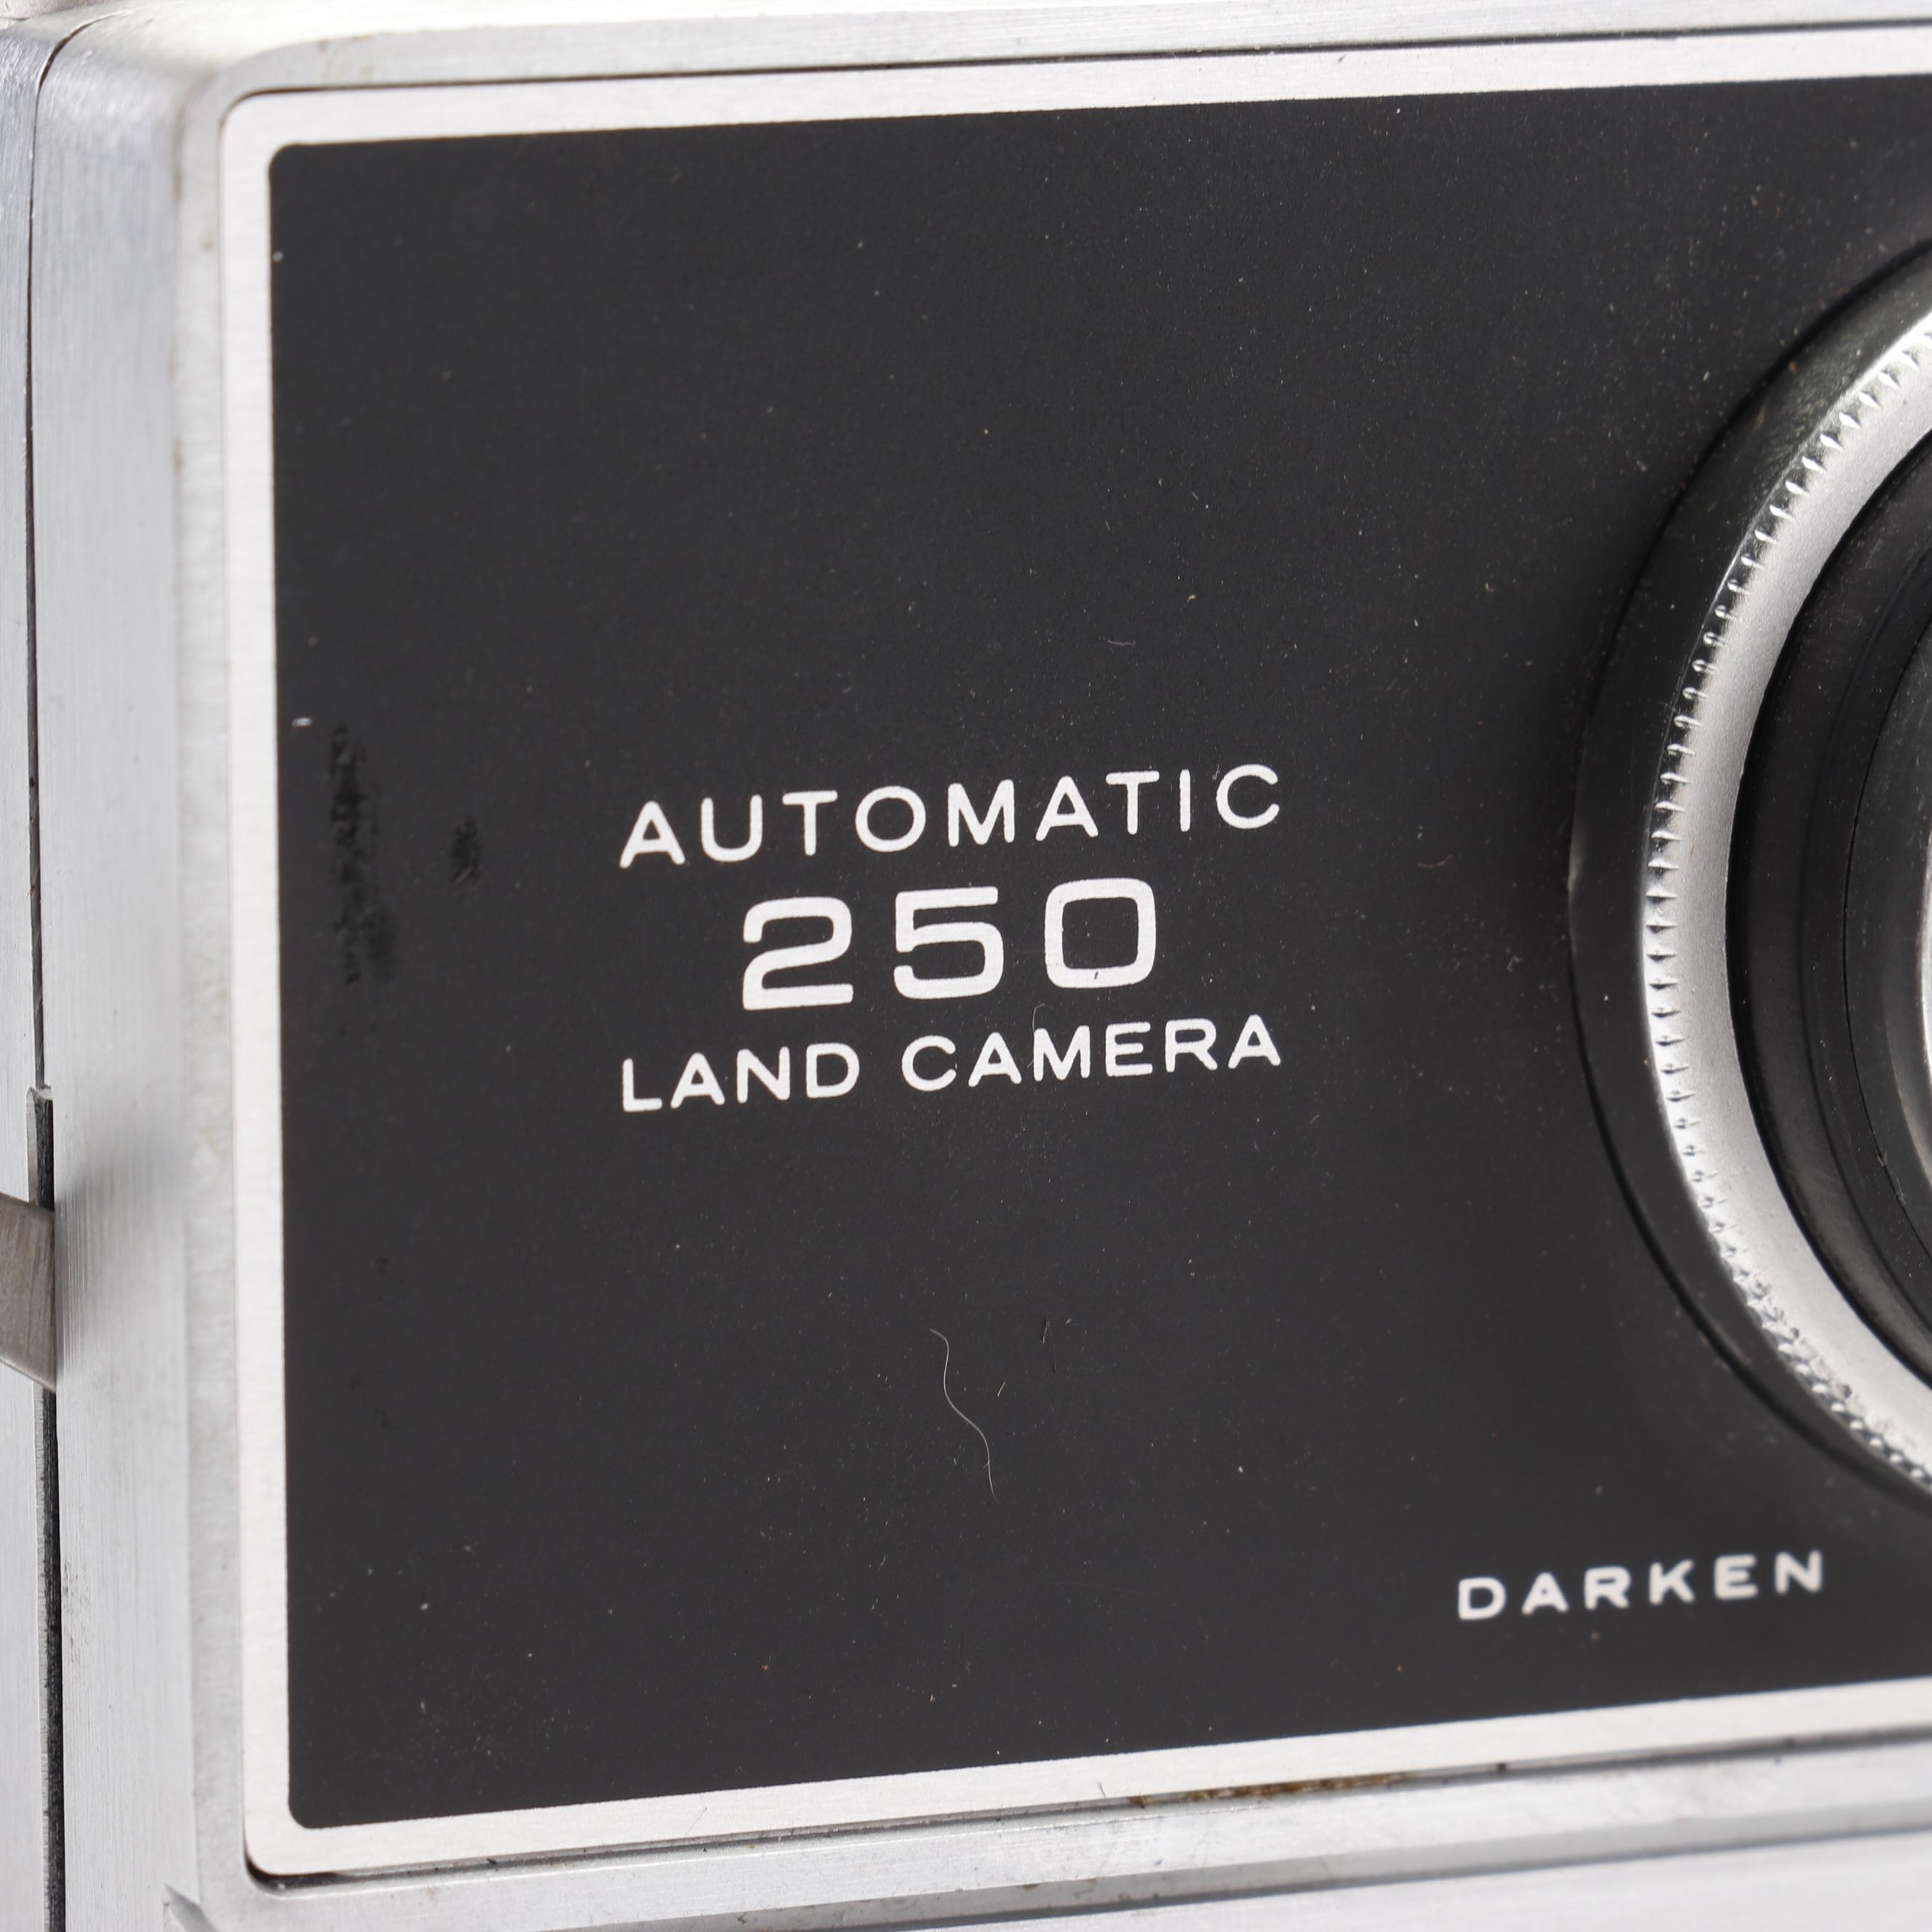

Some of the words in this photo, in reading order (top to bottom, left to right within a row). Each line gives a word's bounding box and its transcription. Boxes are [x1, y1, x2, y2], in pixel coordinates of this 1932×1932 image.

[619, 764, 1281, 869] AUTOMATIC
[742, 877, 1157, 1010] 250
[621, 1042, 860, 1113] LAND
[901, 1014, 1282, 1092] CAMERA
[1458, 1550, 1823, 1621] DARKEN
